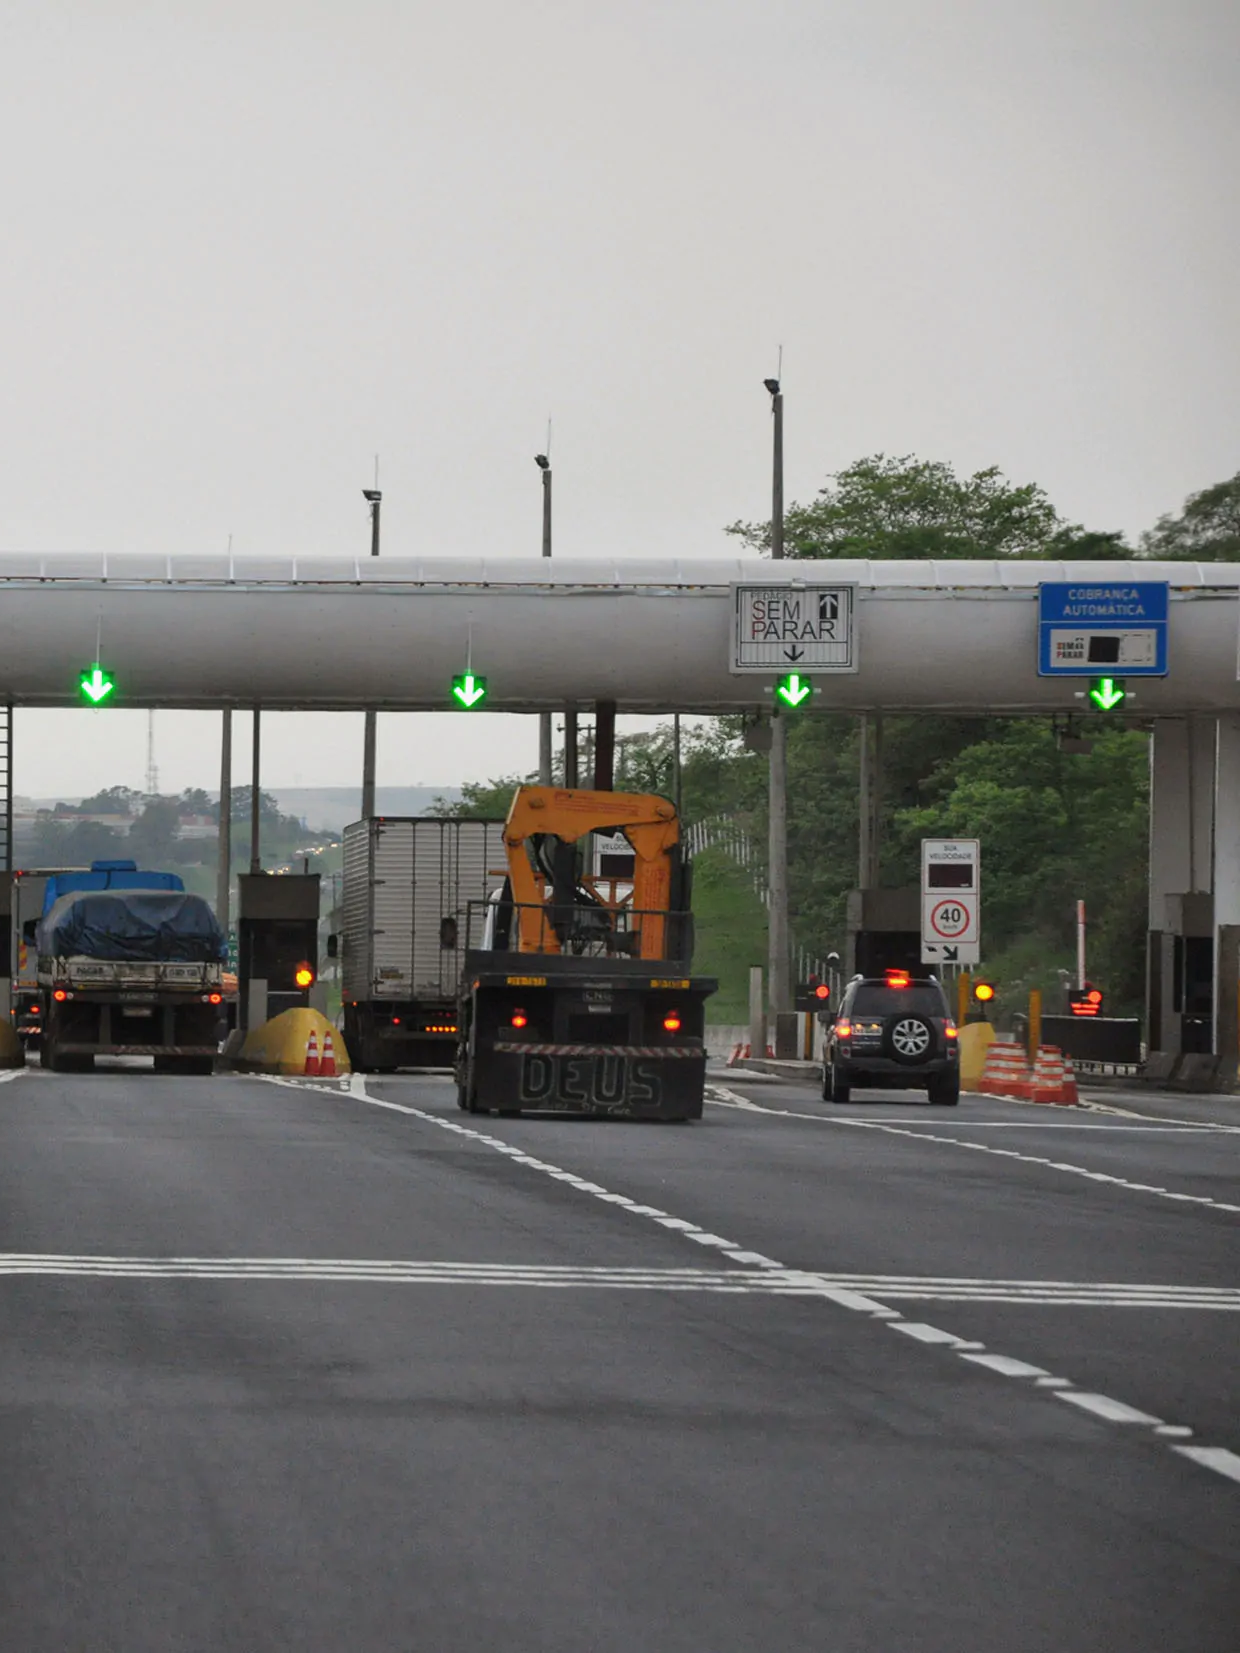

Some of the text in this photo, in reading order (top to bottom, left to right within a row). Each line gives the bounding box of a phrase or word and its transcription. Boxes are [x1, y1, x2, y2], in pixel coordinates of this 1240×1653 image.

[1068, 589, 1139, 602] COBRANÇA
[752, 600, 800, 620] SEM
[1063, 602, 1145, 616] AUTOMÁTICA
[751, 621, 835, 640] PARAR
[940, 908, 961, 922] 40
